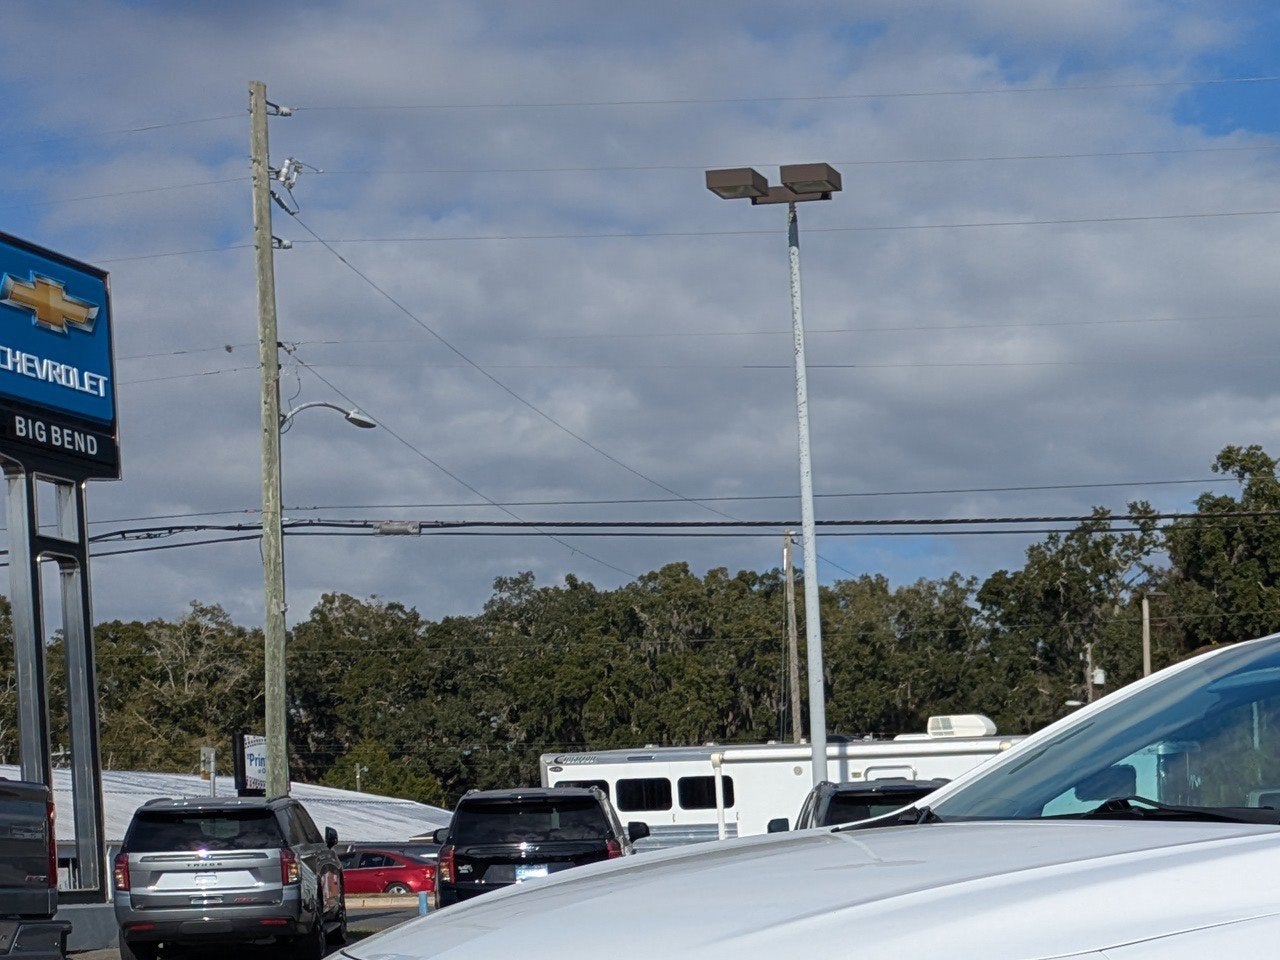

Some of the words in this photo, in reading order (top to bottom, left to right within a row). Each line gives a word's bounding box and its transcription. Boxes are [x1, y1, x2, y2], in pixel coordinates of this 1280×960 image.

[0, 345, 108, 397] CHEVROLET
[15, 415, 47, 442] BIG
[50, 425, 98, 455] BEND
